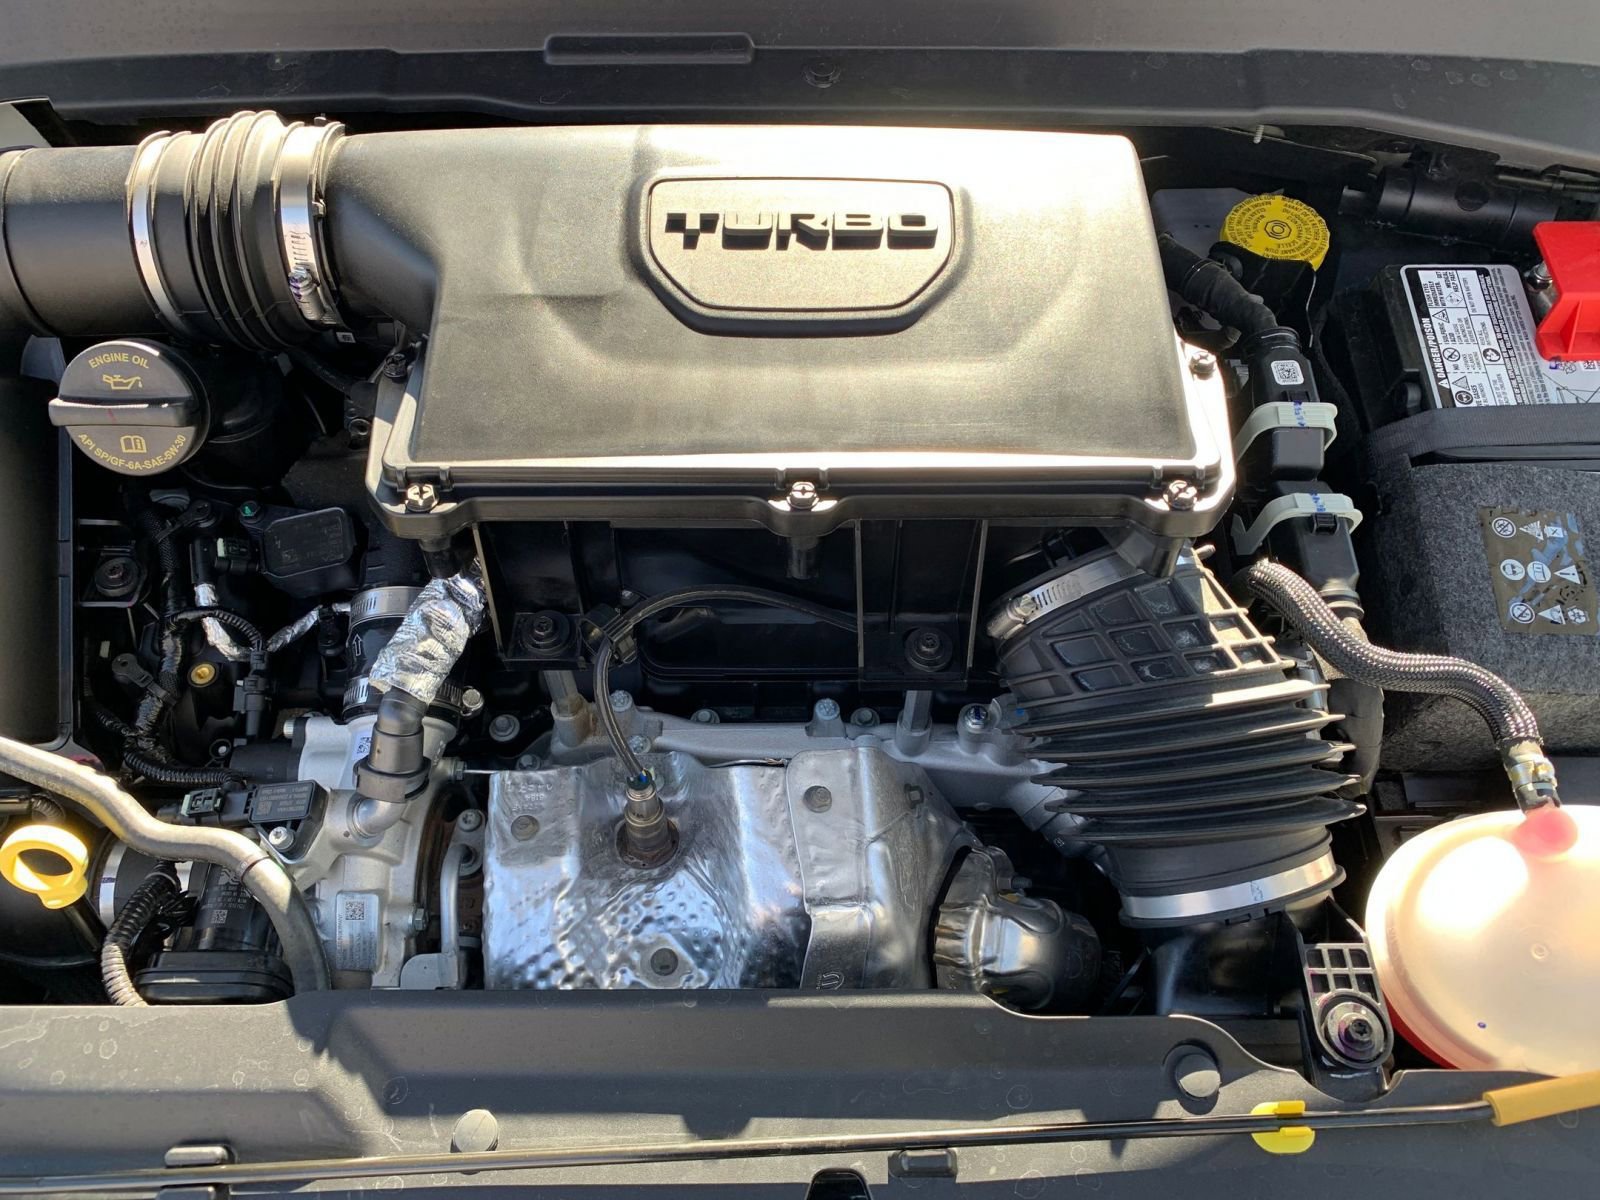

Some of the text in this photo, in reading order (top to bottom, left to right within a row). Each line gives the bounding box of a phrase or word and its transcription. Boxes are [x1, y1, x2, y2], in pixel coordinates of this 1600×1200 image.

[664, 211, 939, 251] TURBO
[1444, 272, 1452, 288] MEDICAL
[1425, 293, 1434, 306] FLUSH
[1428, 281, 1440, 306] IMMEDIATELY
[1439, 322, 1449, 342] SULFURIC
[1422, 317, 1445, 377] DANGER/POISON
[88, 352, 150, 369] ENGINE OIL
[1471, 385, 1479, 399] GASES
[78, 434, 186, 470] API SP/GF-6A-SAE-5W-30
